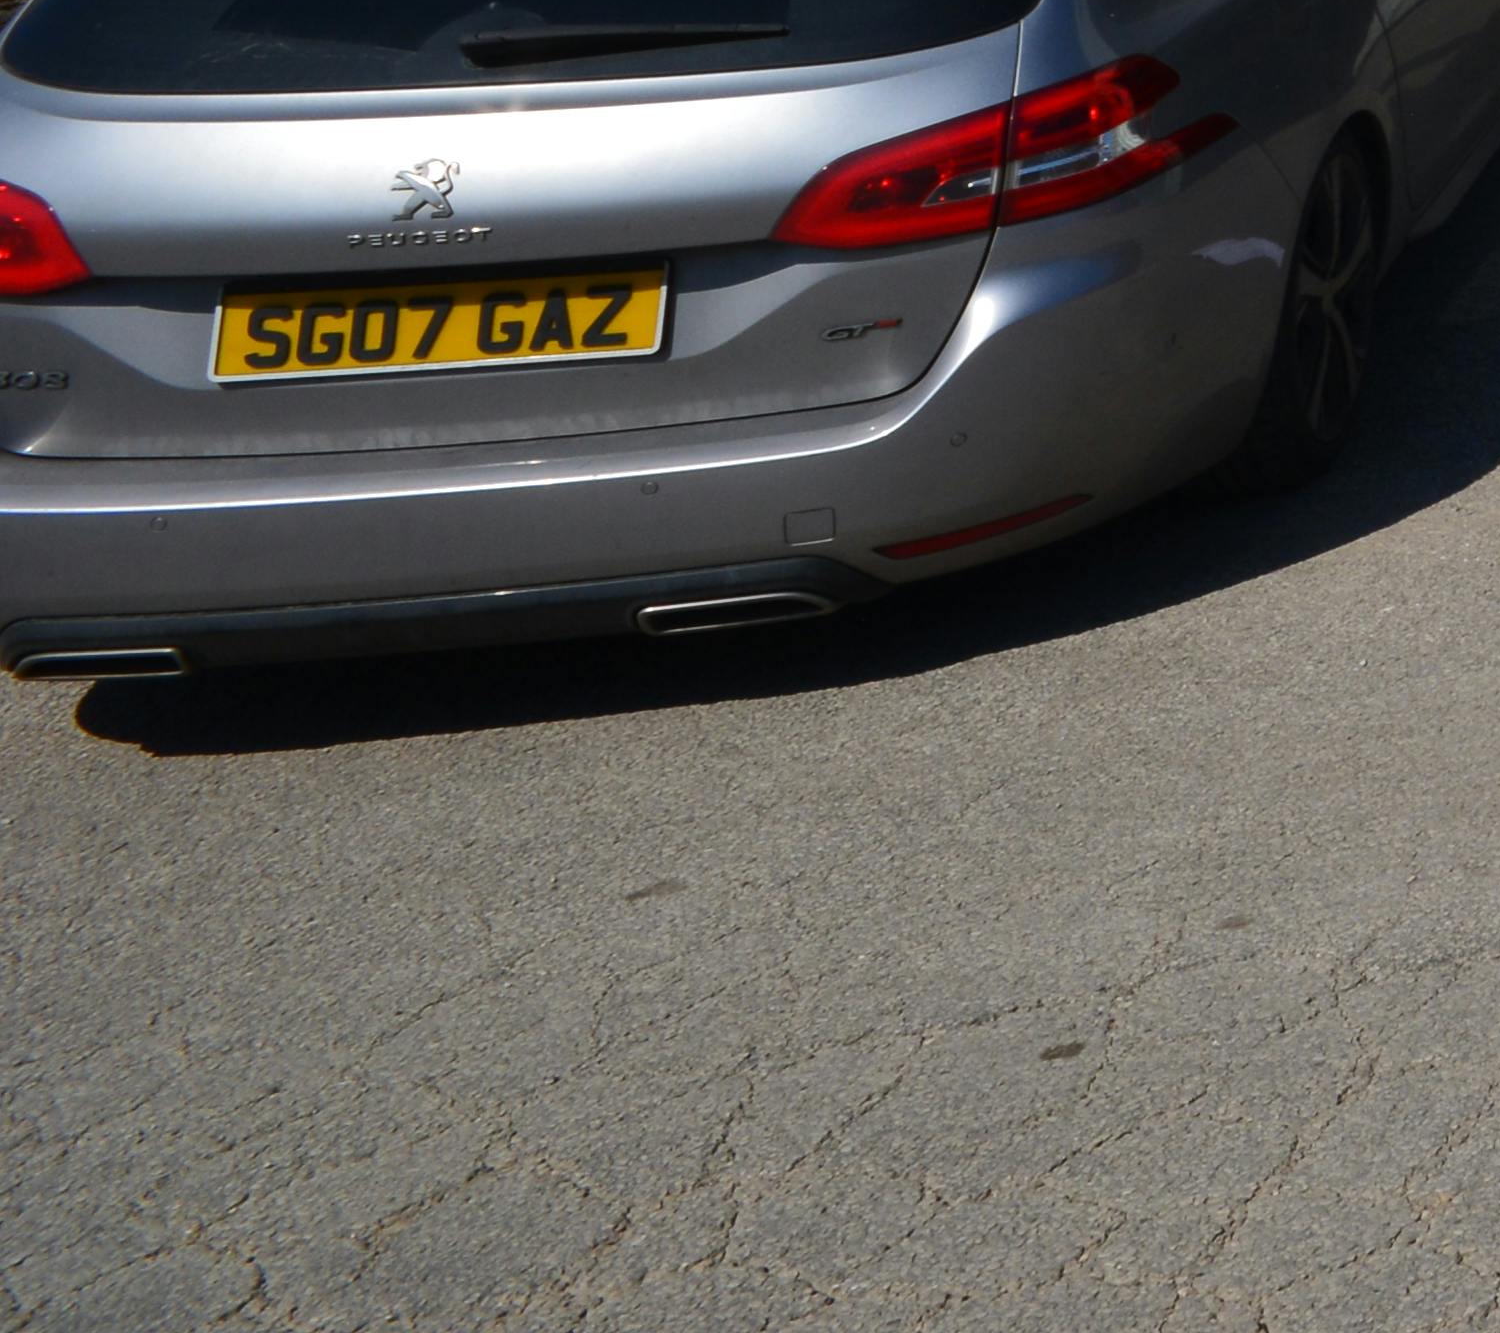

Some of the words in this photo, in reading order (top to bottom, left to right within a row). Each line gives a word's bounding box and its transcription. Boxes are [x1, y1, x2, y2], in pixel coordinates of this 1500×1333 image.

[346, 226, 493, 248] PEUGEOT
[243, 294, 456, 370] SG07
[476, 283, 635, 356] GAZ
